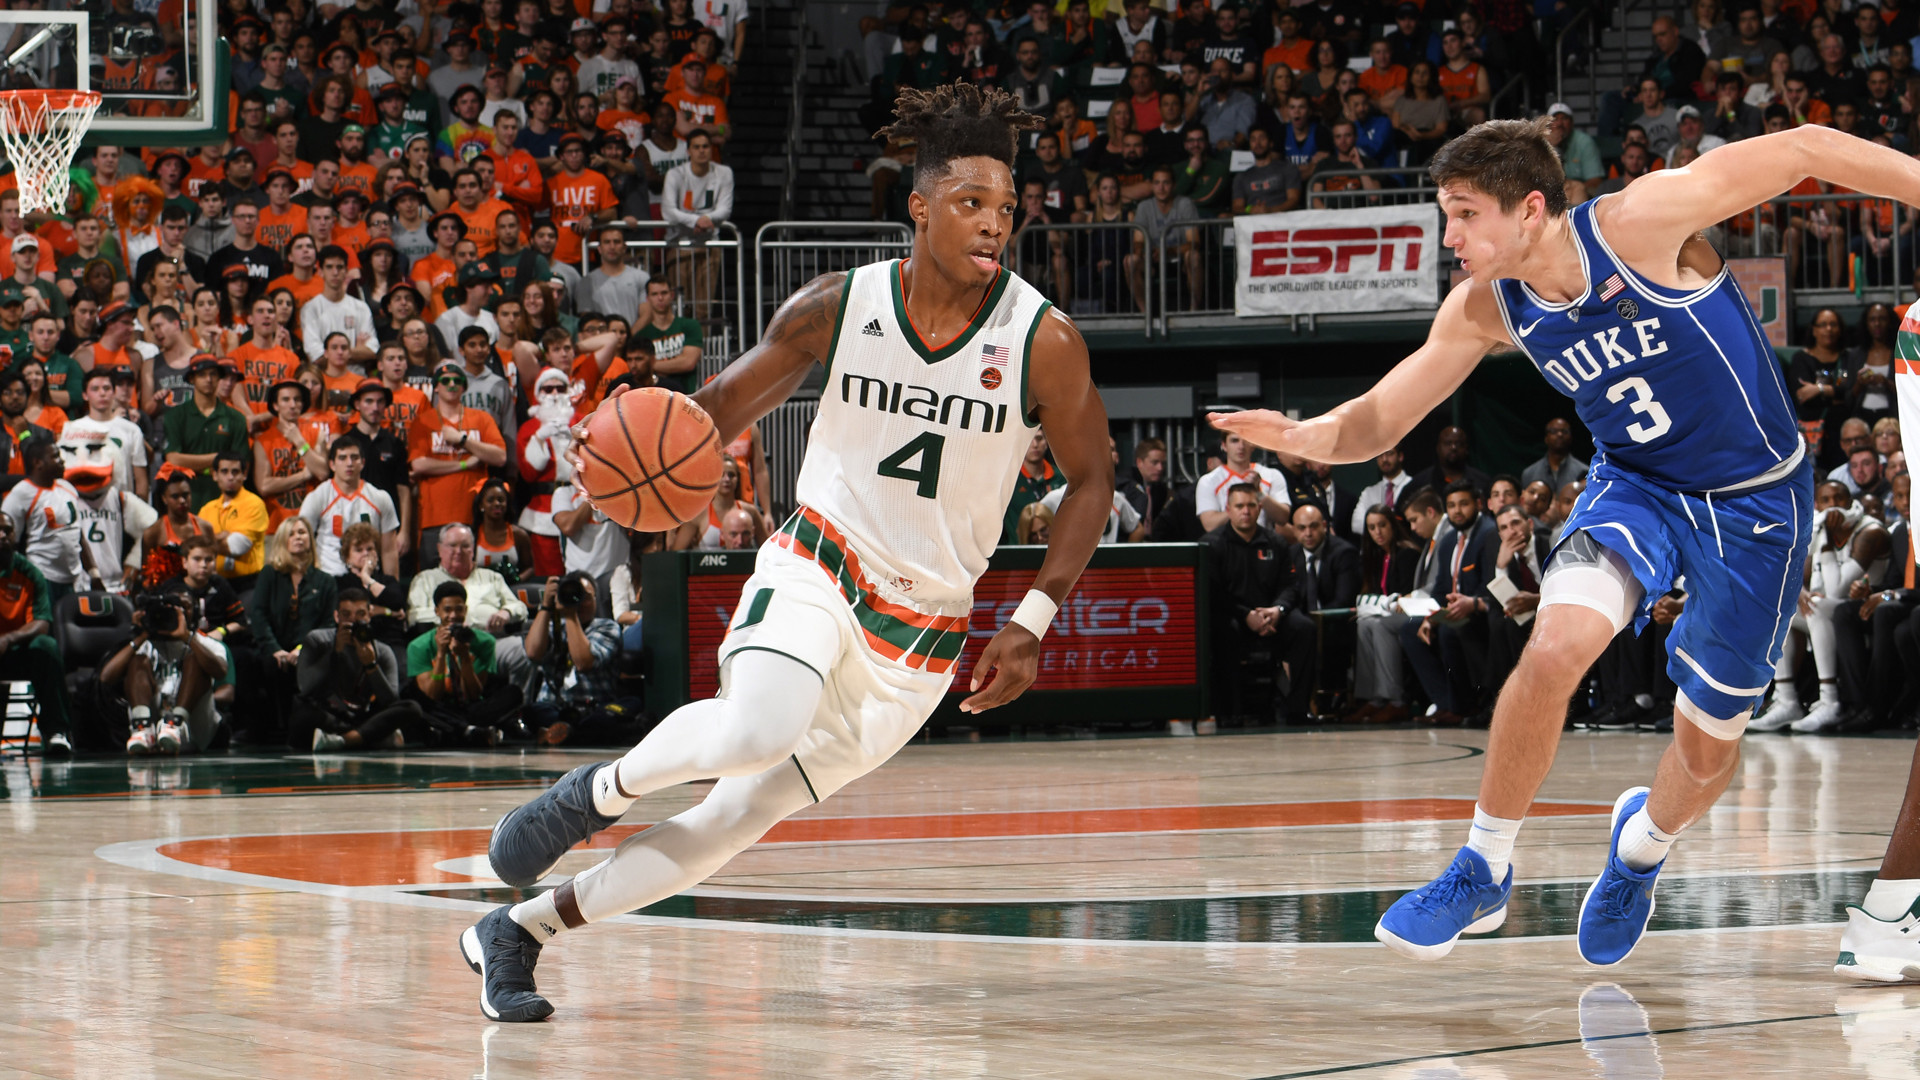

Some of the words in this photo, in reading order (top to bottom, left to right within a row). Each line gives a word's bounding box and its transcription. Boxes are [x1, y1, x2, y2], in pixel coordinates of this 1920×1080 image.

[1204, 47, 1244, 63] DUKE
[552, 186, 595, 206] LIVE
[1250, 225, 1424, 277] ESPN
[1249, 284, 1265, 294] THE
[1270, 281, 1325, 293] WORLDWIDE
[1329, 279, 1365, 291] LEADER
[1368, 278, 1378, 289] IN
[1380, 278, 1418, 289] SPORTS
[1544, 317, 1669, 391] DUKE
[244, 360, 287, 380] ROCK
[842, 373, 1007, 433] MIAMI
[1606, 377, 1672, 444] 3
[877, 431, 945, 500] 4
[88, 521, 105, 543] 6
[699, 554, 727, 566] ANC
[78, 596, 113, 616] U
[1042, 648, 1160, 671] ERICAS
